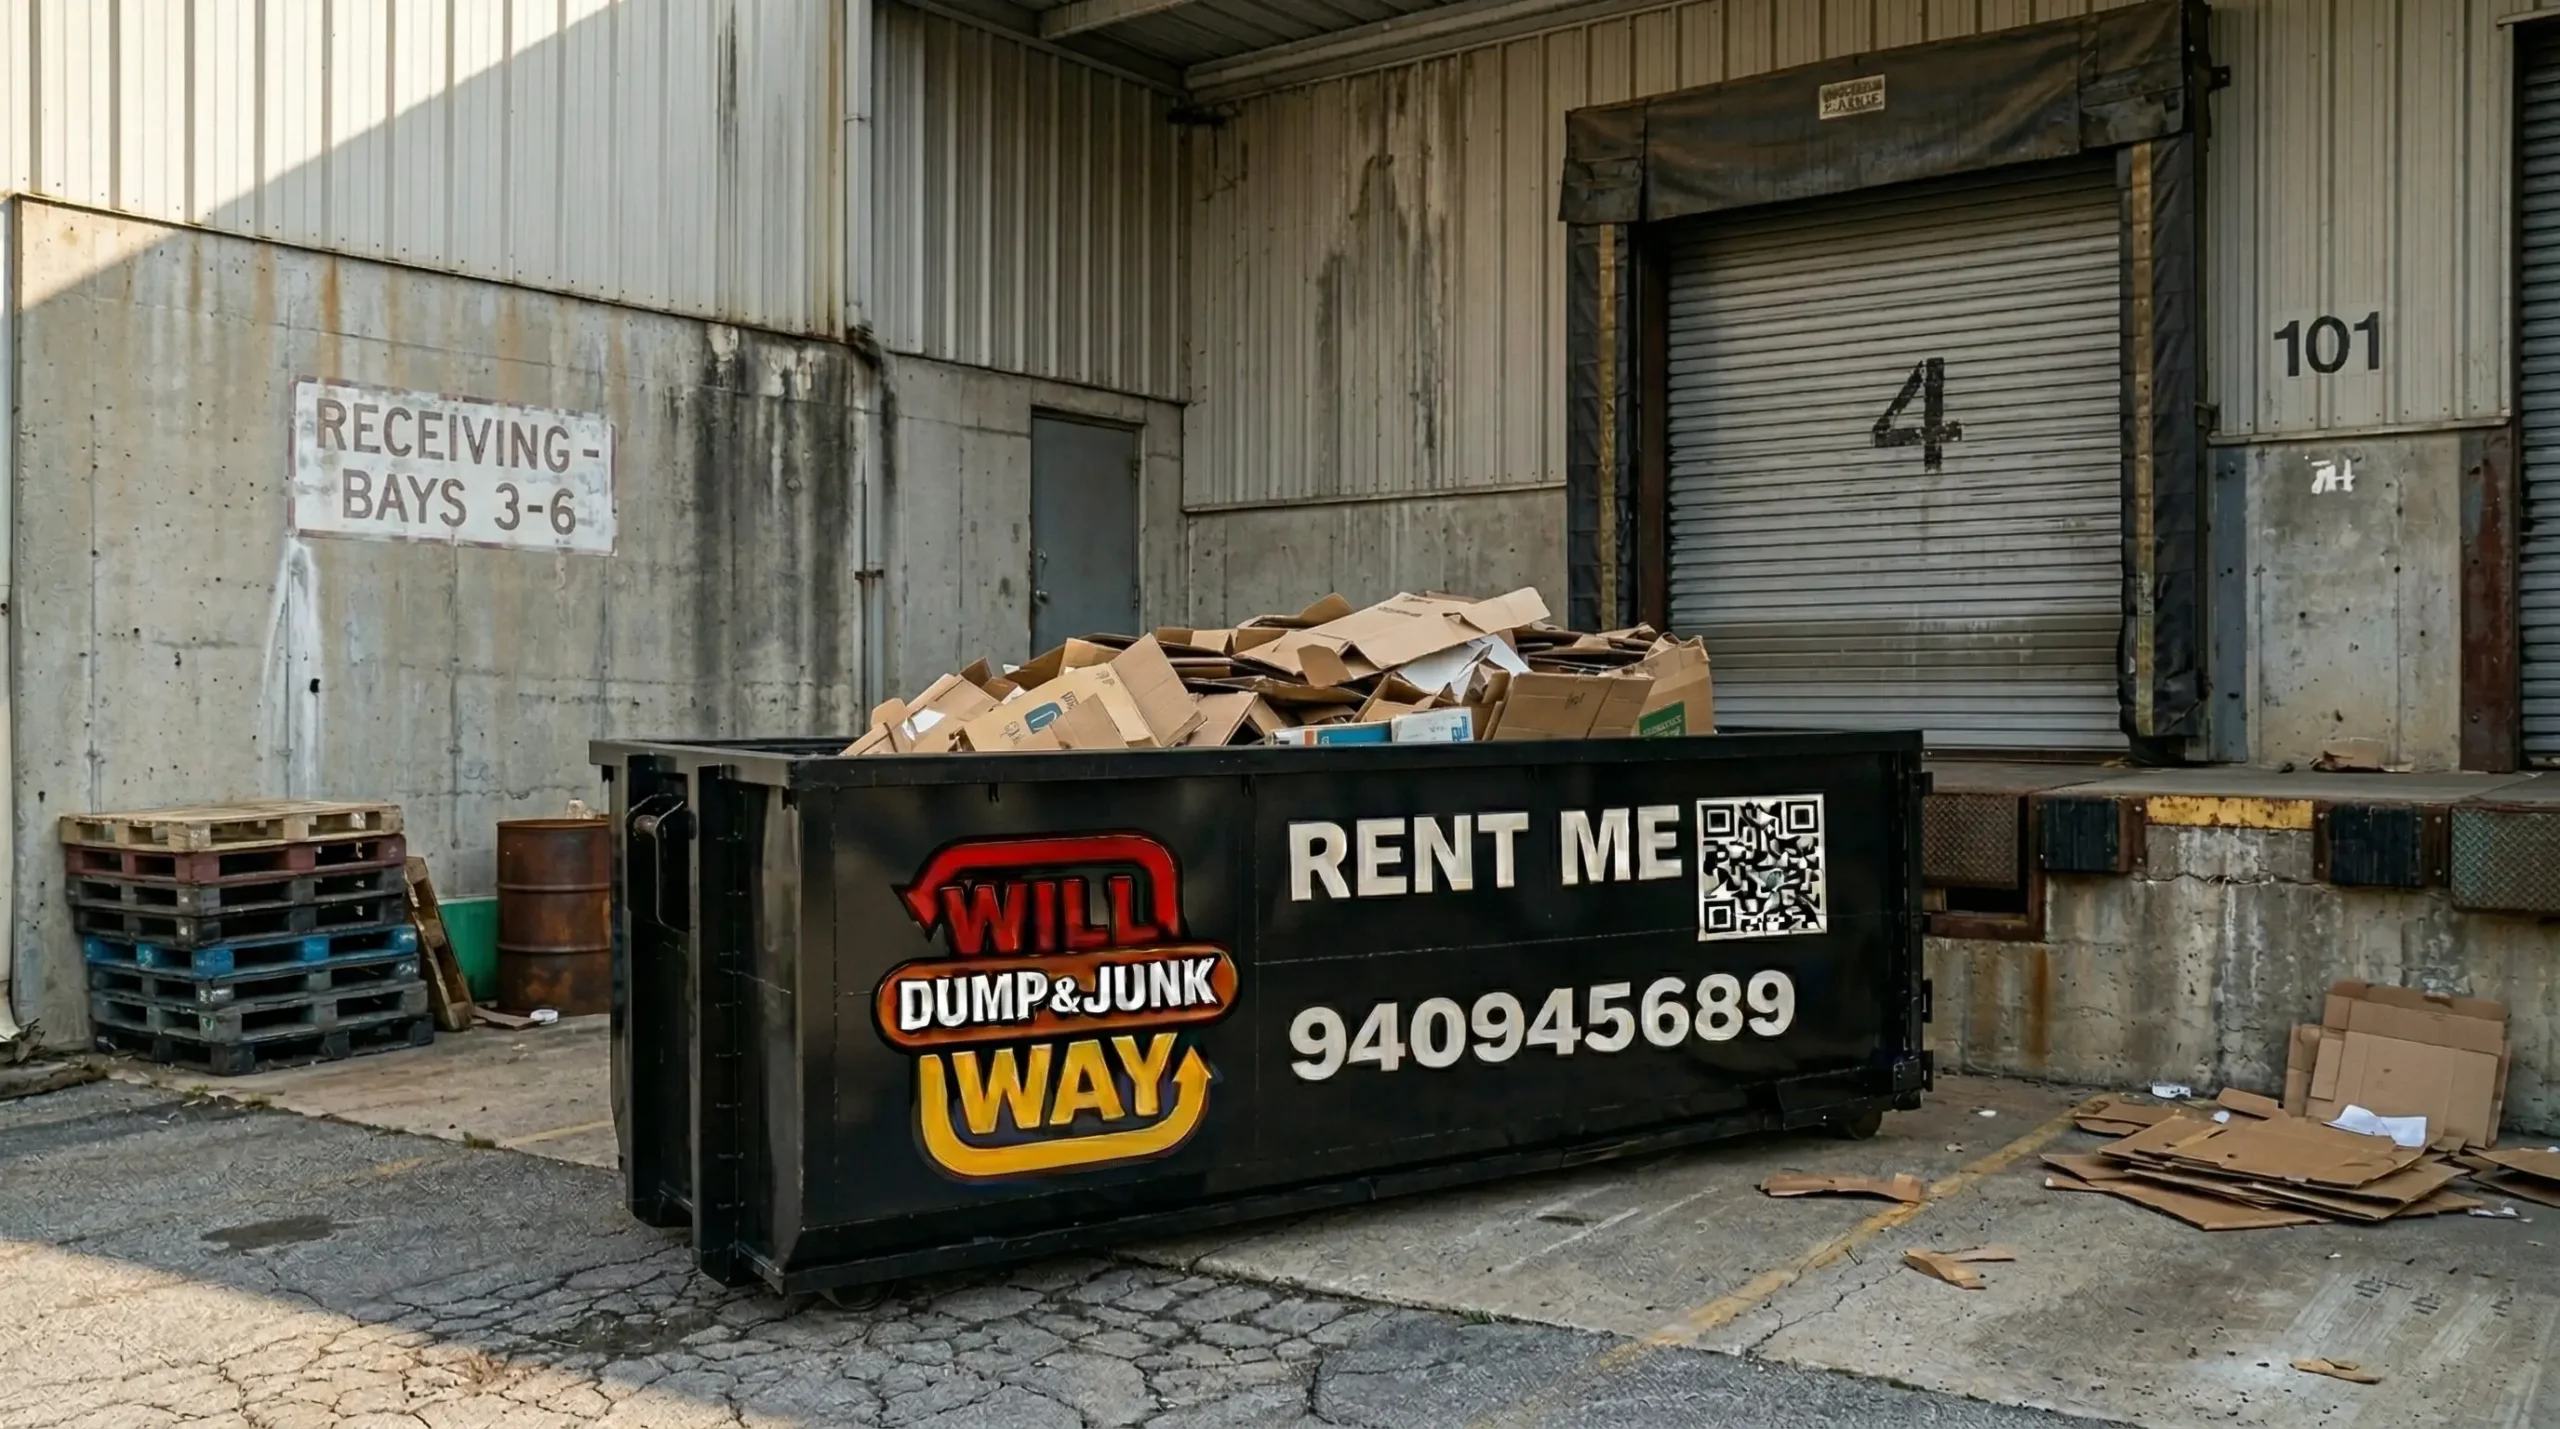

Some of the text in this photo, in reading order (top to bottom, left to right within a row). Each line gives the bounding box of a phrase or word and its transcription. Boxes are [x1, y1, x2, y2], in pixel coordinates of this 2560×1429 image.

[2273, 311, 2380, 377] 101
[1872, 357, 1963, 474] 4
[342, 468, 577, 535] BAYS 3-6
[1288, 804, 1684, 901] RENT ME
[940, 875, 1159, 955] WILL
[1289, 969, 1796, 1081] 940945689
[951, 1031, 1179, 1135] WAY
